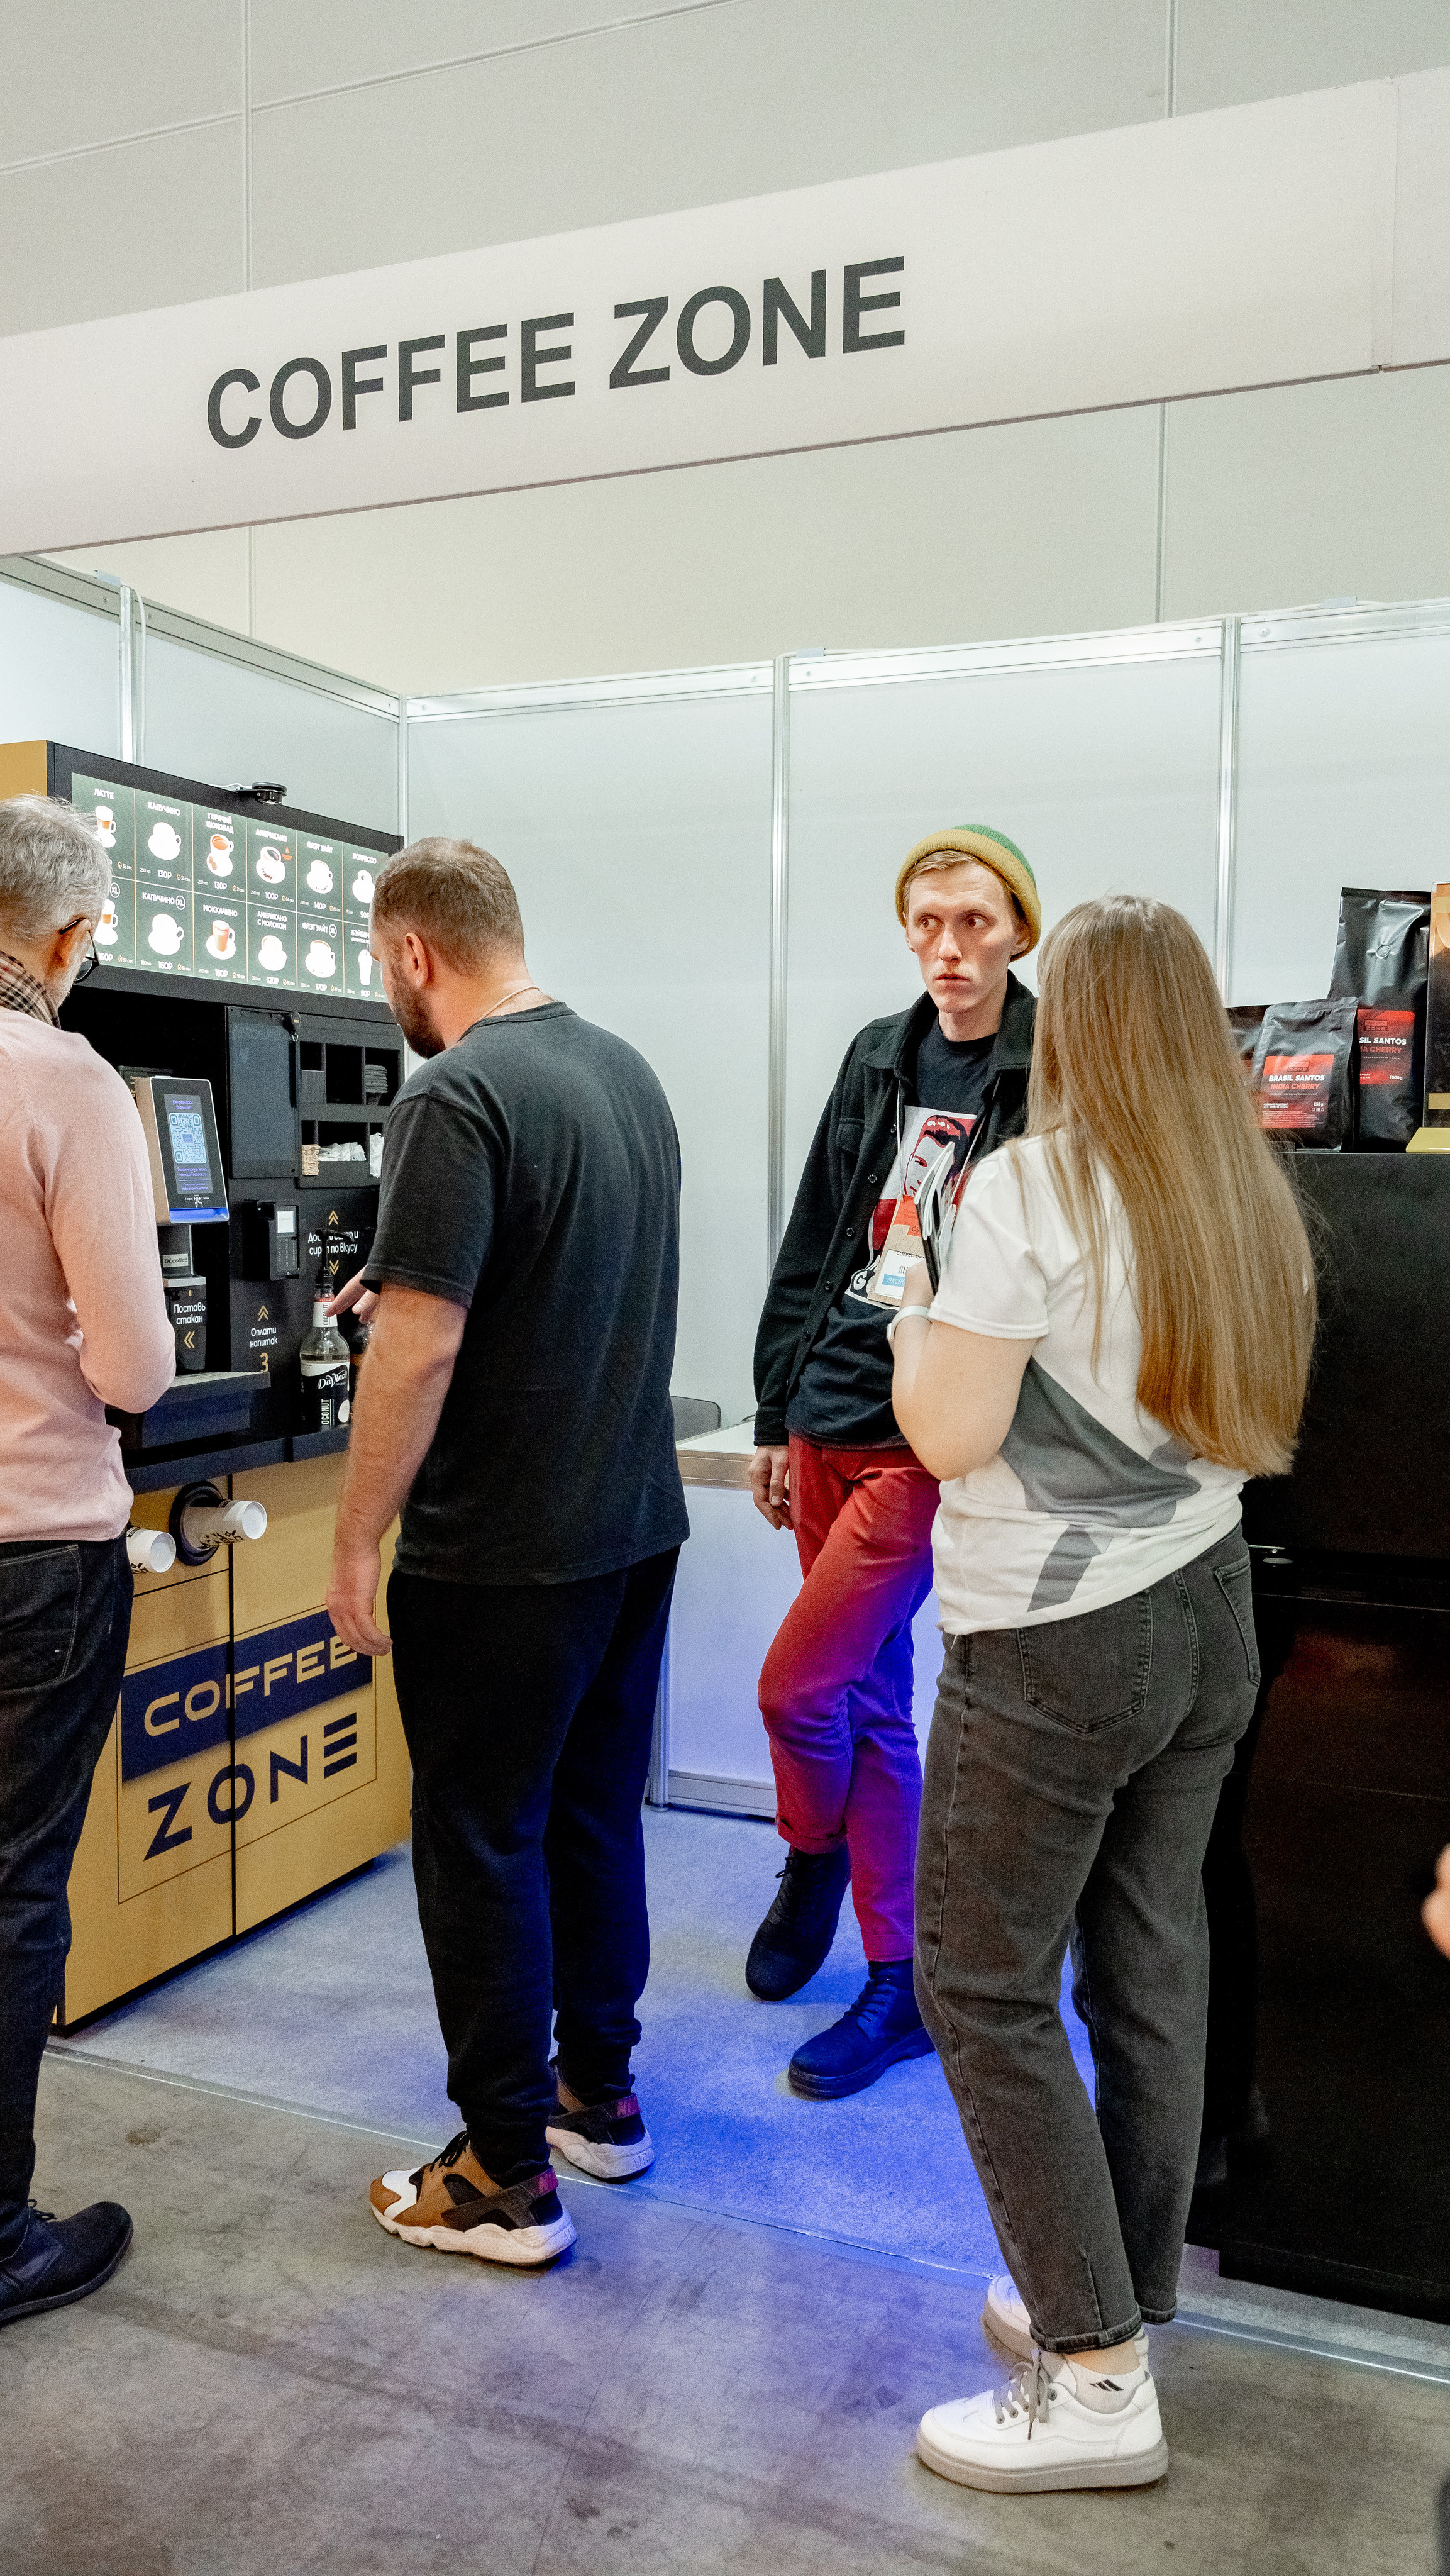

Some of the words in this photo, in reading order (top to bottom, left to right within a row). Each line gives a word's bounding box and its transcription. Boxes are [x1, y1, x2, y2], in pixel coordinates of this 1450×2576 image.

[207, 312, 575, 449] COFFEE
[609, 256, 905, 390] ZONE
[94, 787, 114, 800] ЛАТТЕ
[148, 801, 181, 816] КАПУЧИНО
[208, 812, 232, 824] ГОРЯЧИЙ
[206, 820, 234, 835] ШОКОЛАД
[255, 828, 288, 843] АМЕРИКАНО
[352, 852, 377, 865] ЭСПРЕССО
[142, 892, 175, 905] КАПУЧИНО
[202, 904, 238, 918] МОККАЧИНО
[257, 911, 287, 923] АМЕРИКАНО
[262, 919, 287, 930] МОЛОКОМ
[302, 922, 316, 931] ФЛЭТ
[316, 924, 328, 933] УАЙТ
[1373, 1037, 1407, 1045] SANTOS
[309, 1246, 330, 1257] сирп
[331, 1245, 340, 1253] по
[340, 1242, 358, 1255] вкусу
[174, 1301, 206, 1314] Поставь
[176, 1314, 203, 1324] стакан
[250, 1327, 277, 1337] Оплати
[250, 1335, 278, 1348] напиток
[260, 1352, 269, 1372] 3
[321, 1398, 329, 1425] OCONUT
[144, 1635, 357, 1737] COFFEE
[143, 1711, 357, 1862] ZONE
